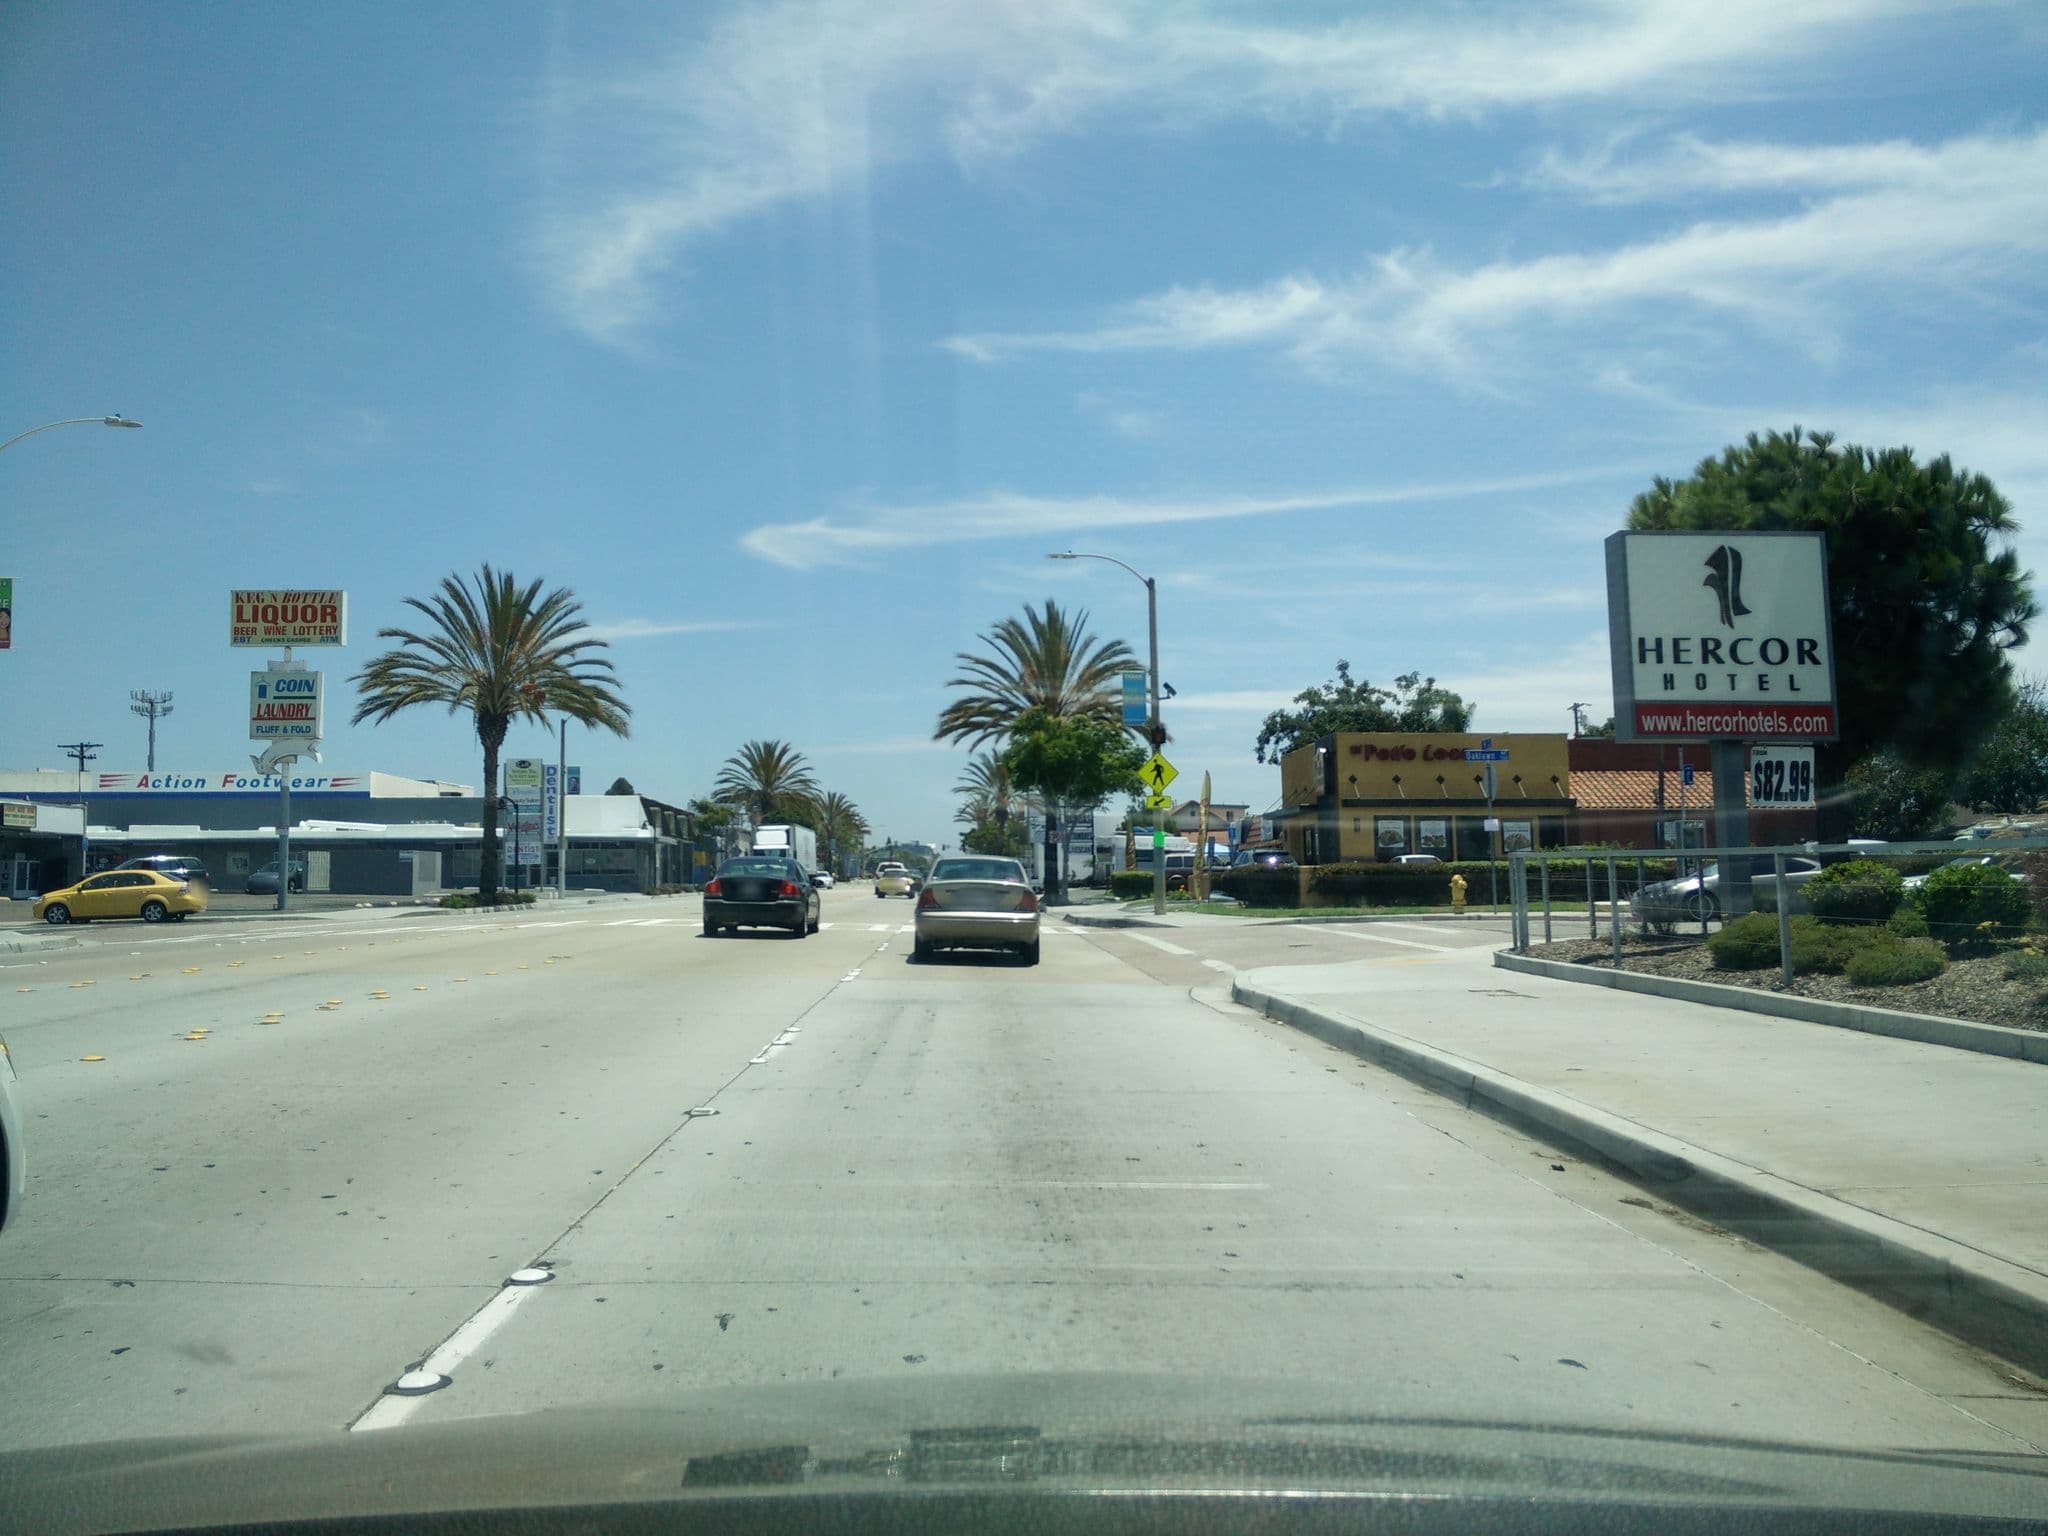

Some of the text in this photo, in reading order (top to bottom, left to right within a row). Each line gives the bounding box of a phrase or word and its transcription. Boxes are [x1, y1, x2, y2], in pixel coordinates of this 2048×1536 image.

[234, 592, 265, 604] KEG
[281, 592, 339, 604] BOTTLE
[236, 604, 338, 625] LIQUOR
[233, 625, 338, 636] BEER WINE LOTTERY
[1638, 637, 1822, 665] HERCOR
[275, 679, 315, 692] COIN
[1663, 673, 1801, 691] HOTEL
[256, 703, 312, 719] LAUNDRY
[256, 725, 280, 734] FLUFF
[291, 725, 311, 734] FOLD
[1641, 710, 1828, 733] www.hercorhotels.com
[137, 774, 207, 789] Action
[1753, 760, 1810, 802] $82.99
[546, 766, 557, 836] Dentist
